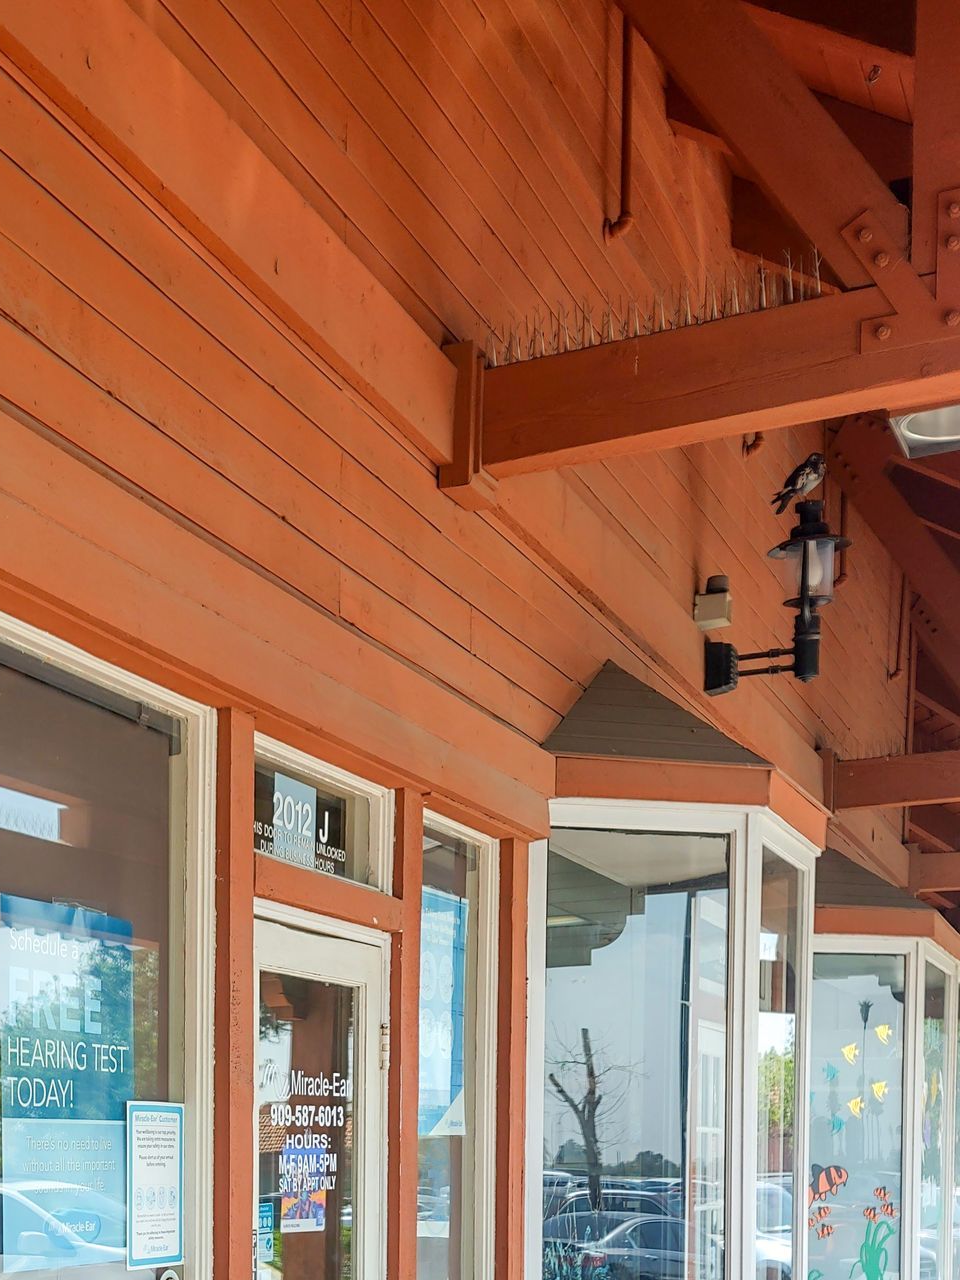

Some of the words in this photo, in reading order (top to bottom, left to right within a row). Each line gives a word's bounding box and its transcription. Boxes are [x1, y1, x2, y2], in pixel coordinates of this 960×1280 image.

[272, 792, 312, 837] 2012
[319, 811, 329, 843] J
[253, 821, 263, 835] HIS
[264, 824, 281, 840] DOOR
[284, 831, 293, 843] TO
[293, 834, 315, 851] REMAIN
[316, 842, 346, 862] UNLOCKED
[260, 839, 284, 858] DURING
[285, 847, 314, 867] BUSINESS
[315, 857, 335, 873] HOURS
[9, 928, 68, 958] Schedule
[71, 945, 79, 959] a
[9, 966, 102, 1035] FREE
[7, 1036, 87, 1071] HEARING
[91, 1043, 129, 1073] TEST
[7, 1076, 74, 1108] TODAY!
[291, 1070, 350, 1097] Miracle-Ear
[270, 1104, 344, 1127] 909-587-6013
[26, 1135, 55, 1151] There's
[57, 1141, 69, 1151] no
[71, 1136, 90, 1150] need
[91, 1138, 99, 1150] to
[101, 1137, 112, 1150] live
[286, 1133, 331, 1149] HOURS:
[23, 1160, 53, 1172] without
[55, 1157, 65, 1171] all
[67, 1158, 81, 1171] the
[82, 1159, 116, 1174] important
[297, 1153, 337, 1173] 9AM-5PM
[278, 1177, 292, 1193] SAT
[292, 1176, 302, 1192] BY
[302, 1177, 319, 1192] APPT
[320, 1175, 336, 1190] ONLY
